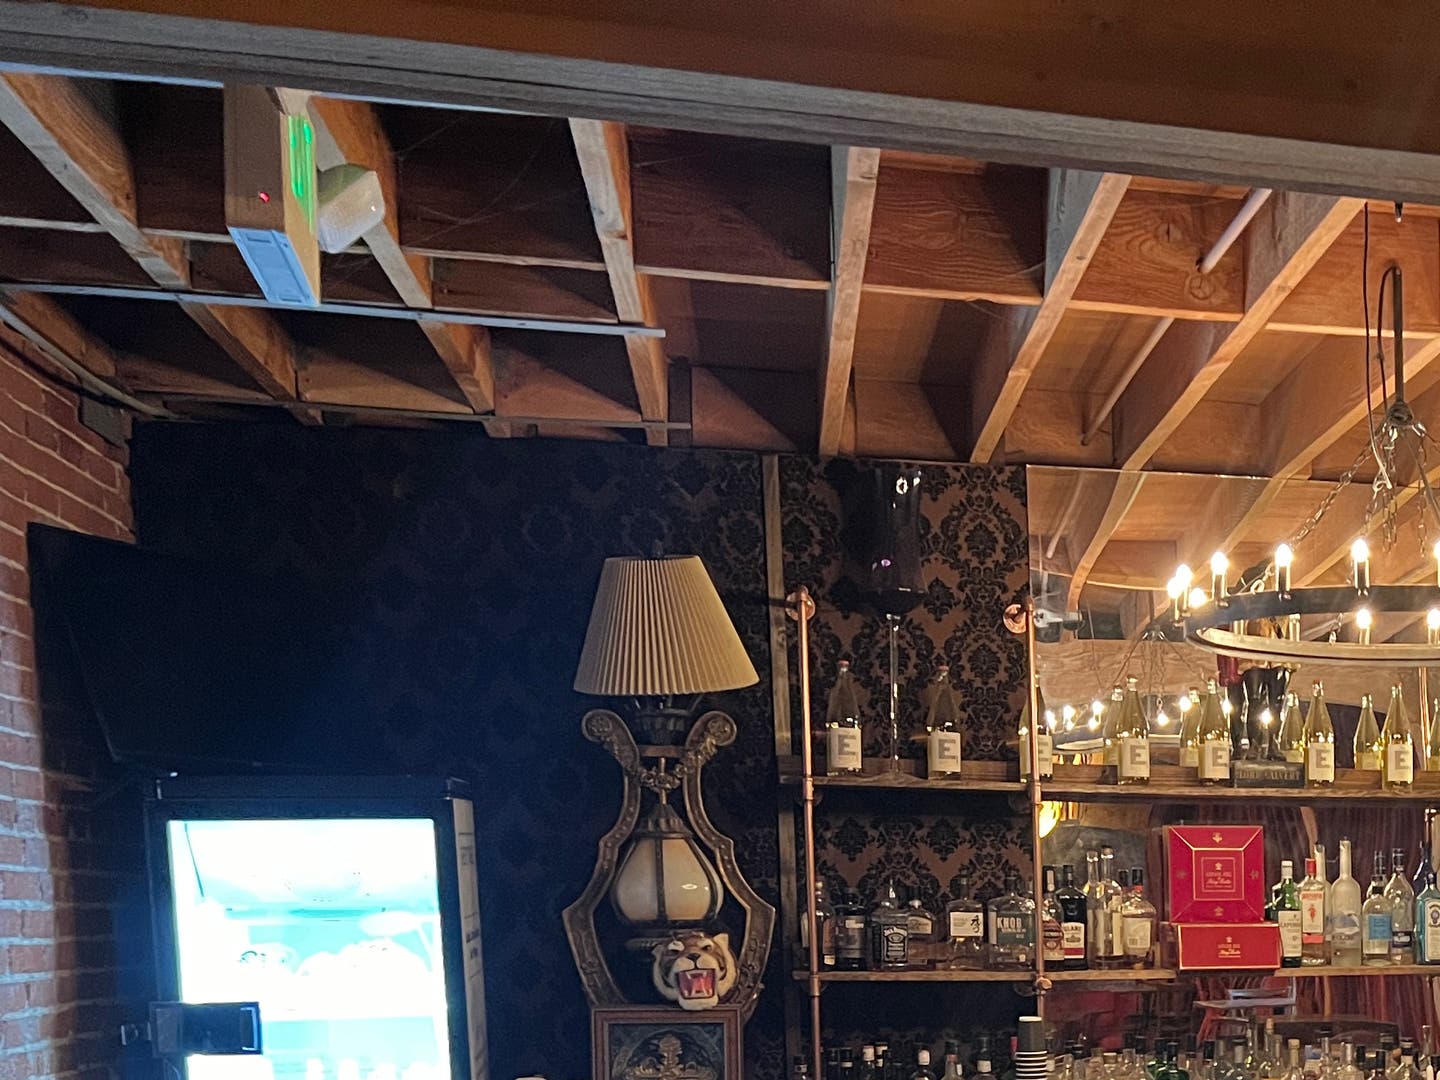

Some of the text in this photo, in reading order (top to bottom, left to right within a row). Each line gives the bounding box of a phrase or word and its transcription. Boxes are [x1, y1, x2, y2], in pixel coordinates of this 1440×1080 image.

[838, 734, 857, 756] E
[938, 738, 957, 760] E
[1130, 742, 1145, 763] E
[1212, 743, 1228, 764] E
[1316, 749, 1332, 769] E
[1395, 750, 1410, 770] E
[997, 917, 1022, 929] KNOB
